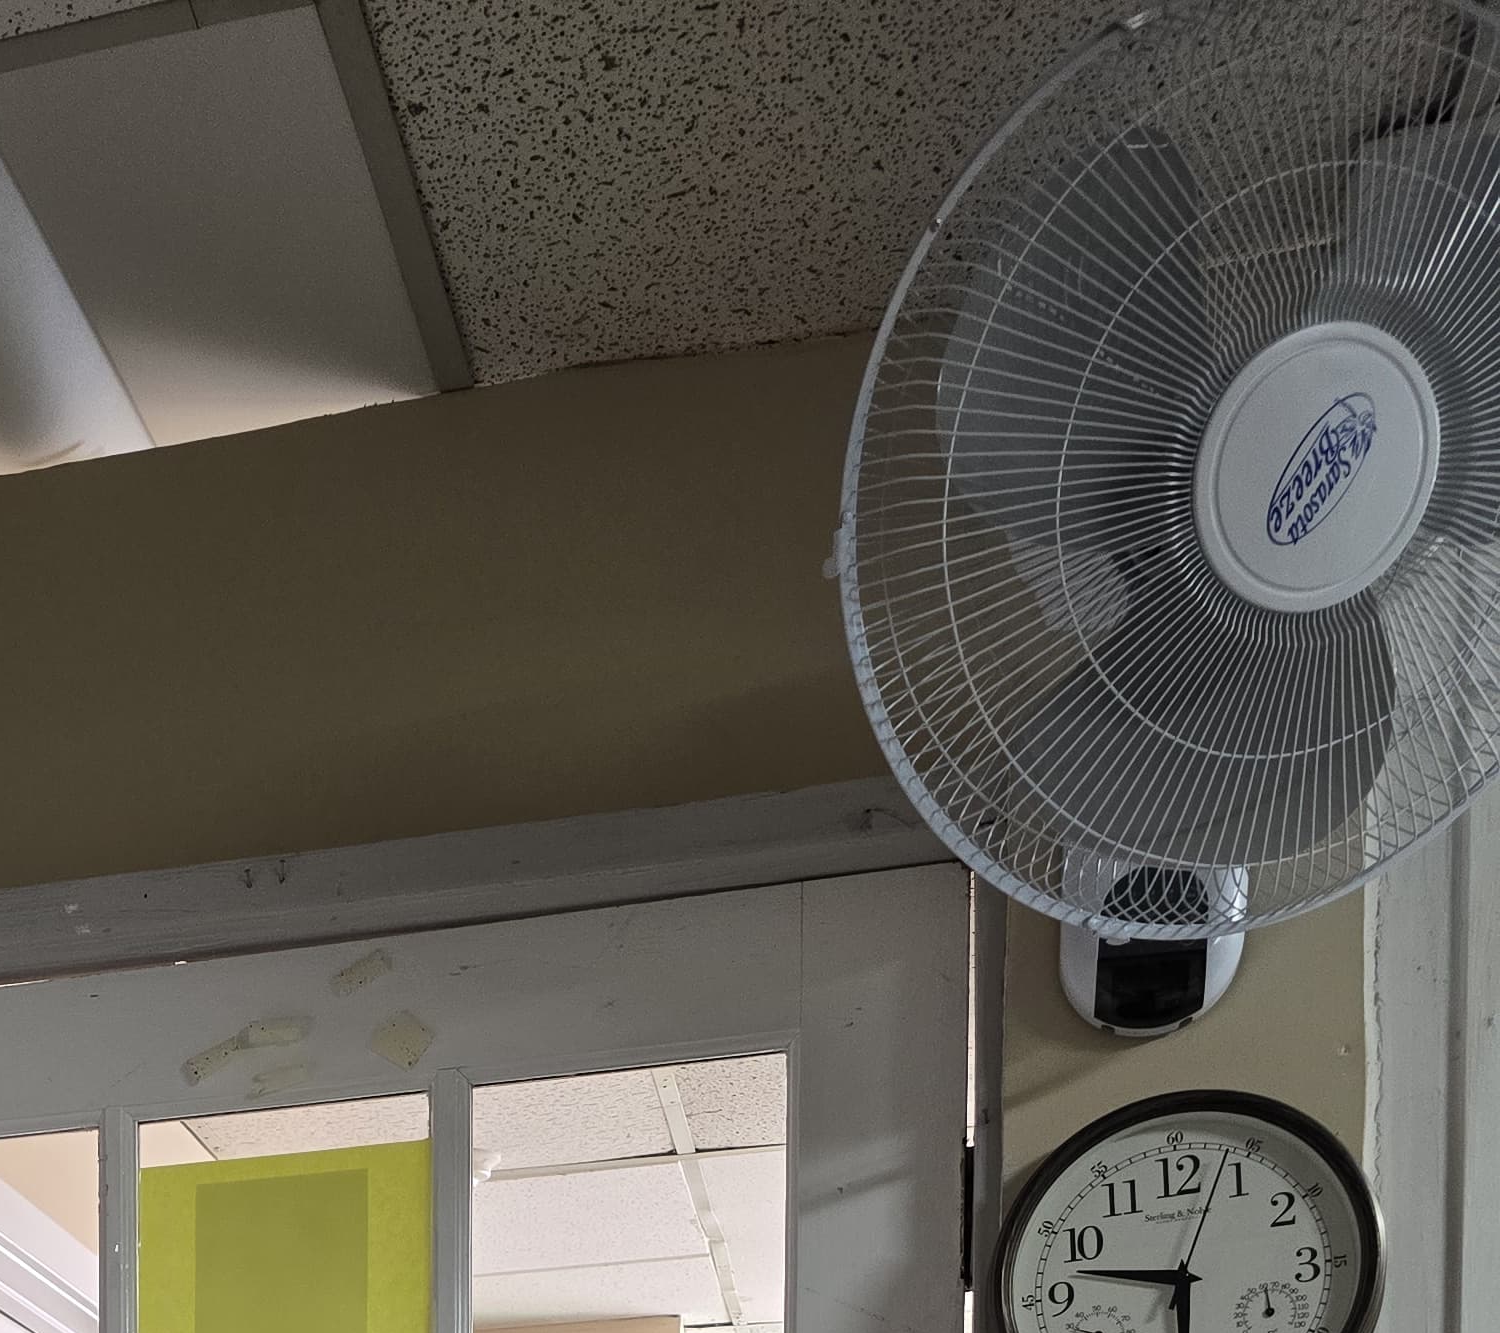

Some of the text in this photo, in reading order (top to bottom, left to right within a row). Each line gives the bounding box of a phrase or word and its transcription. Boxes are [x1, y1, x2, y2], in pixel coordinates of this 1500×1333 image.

[1270, 426, 1340, 533] Breeze
[1287, 446, 1351, 545] Sarasota
[1167, 1130, 1184, 1145] 60
[1245, 1137, 1263, 1153] 05
[1090, 1161, 1108, 1179] 55
[1154, 1154, 1202, 1199] 12
[1228, 1162, 1249, 1198] 1
[1101, 1179, 1143, 1218] 11
[1306, 1182, 1323, 1198] 10
[1269, 1191, 1297, 1228] 2
[1037, 1220, 1054, 1238] 50
[1062, 1225, 1104, 1263] 10
[1294, 1246, 1321, 1283] 3
[1333, 1254, 1347, 1268] 15
[1022, 1294, 1036, 1311] 45
[1047, 1281, 1075, 1318] 9
